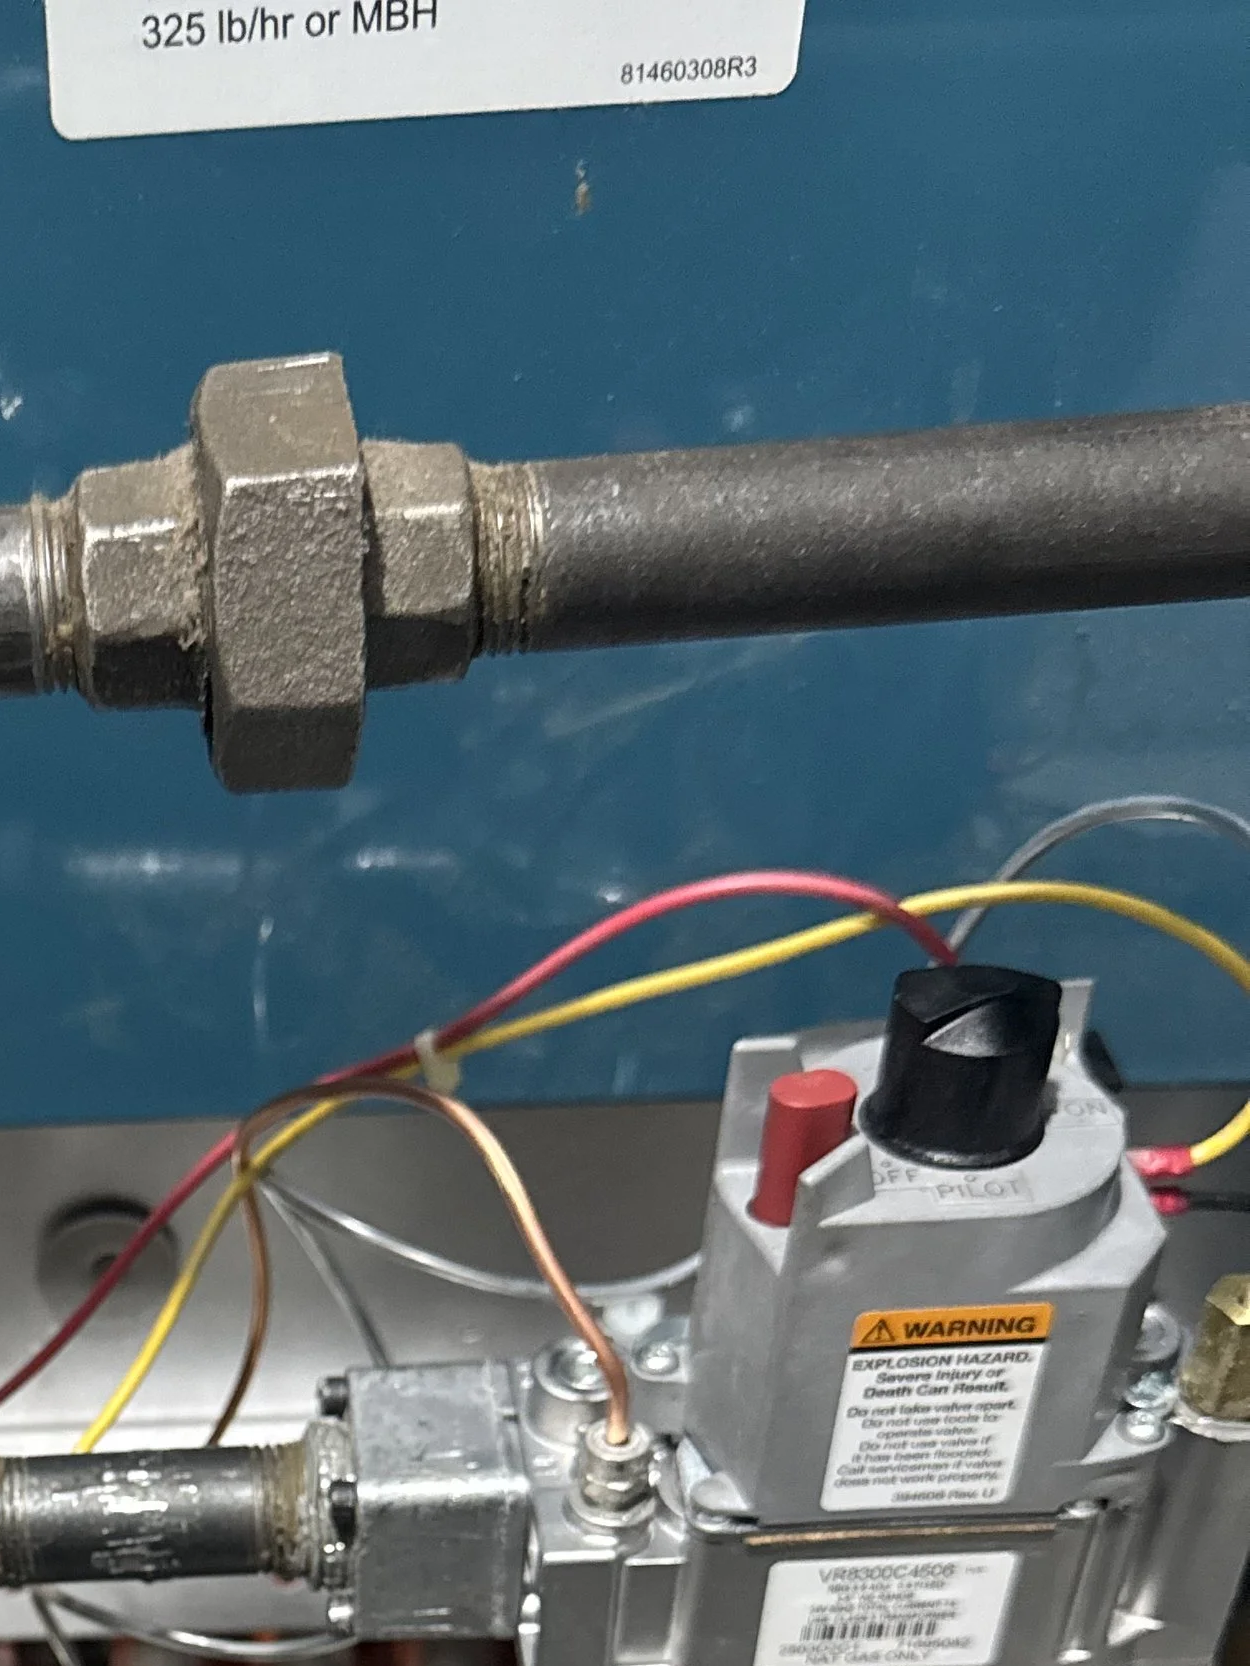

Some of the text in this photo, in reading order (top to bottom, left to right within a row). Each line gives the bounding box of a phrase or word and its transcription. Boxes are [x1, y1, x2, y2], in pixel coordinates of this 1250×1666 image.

[141, 0, 438, 49] 325 lb/hr or MBH
[620, 54, 758, 85] 81460308R3
[904, 1316, 1036, 1340] WARNING
[852, 1351, 1033, 1371] EXPLOSION HAZARD.
[876, 1367, 1004, 1384] Severe Injury or
[863, 1384, 912, 1399] Death
[915, 1383, 949, 1397] Can
[846, 1406, 868, 1418] Do
[871, 1405, 897, 1417] not
[899, 1403, 931, 1415] take
[934, 1401, 973, 1413] valve
[861, 1417, 883, 1429] Do
[886, 1416, 911, 1427] not
[913, 1416, 940, 1426] use
[943, 1414, 979, 1425] tools
[877, 1428, 933, 1441] operate
[859, 1440, 881, 1452] Do
[883, 1440, 909, 1451] not
[911, 1439, 938, 1449] use
[941, 1437, 978, 1448] valve
[864, 1452, 890, 1463] has
[893, 1450, 930, 1462] been
[837, 1463, 865, 1475] Call
[868, 1463, 950, 1474] serviceman
[965, 1459, 1002, 1470] valve
[834, 1475, 869, 1488] does
[872, 1475, 898, 1486] not
[900, 1473, 934, 1484] work
